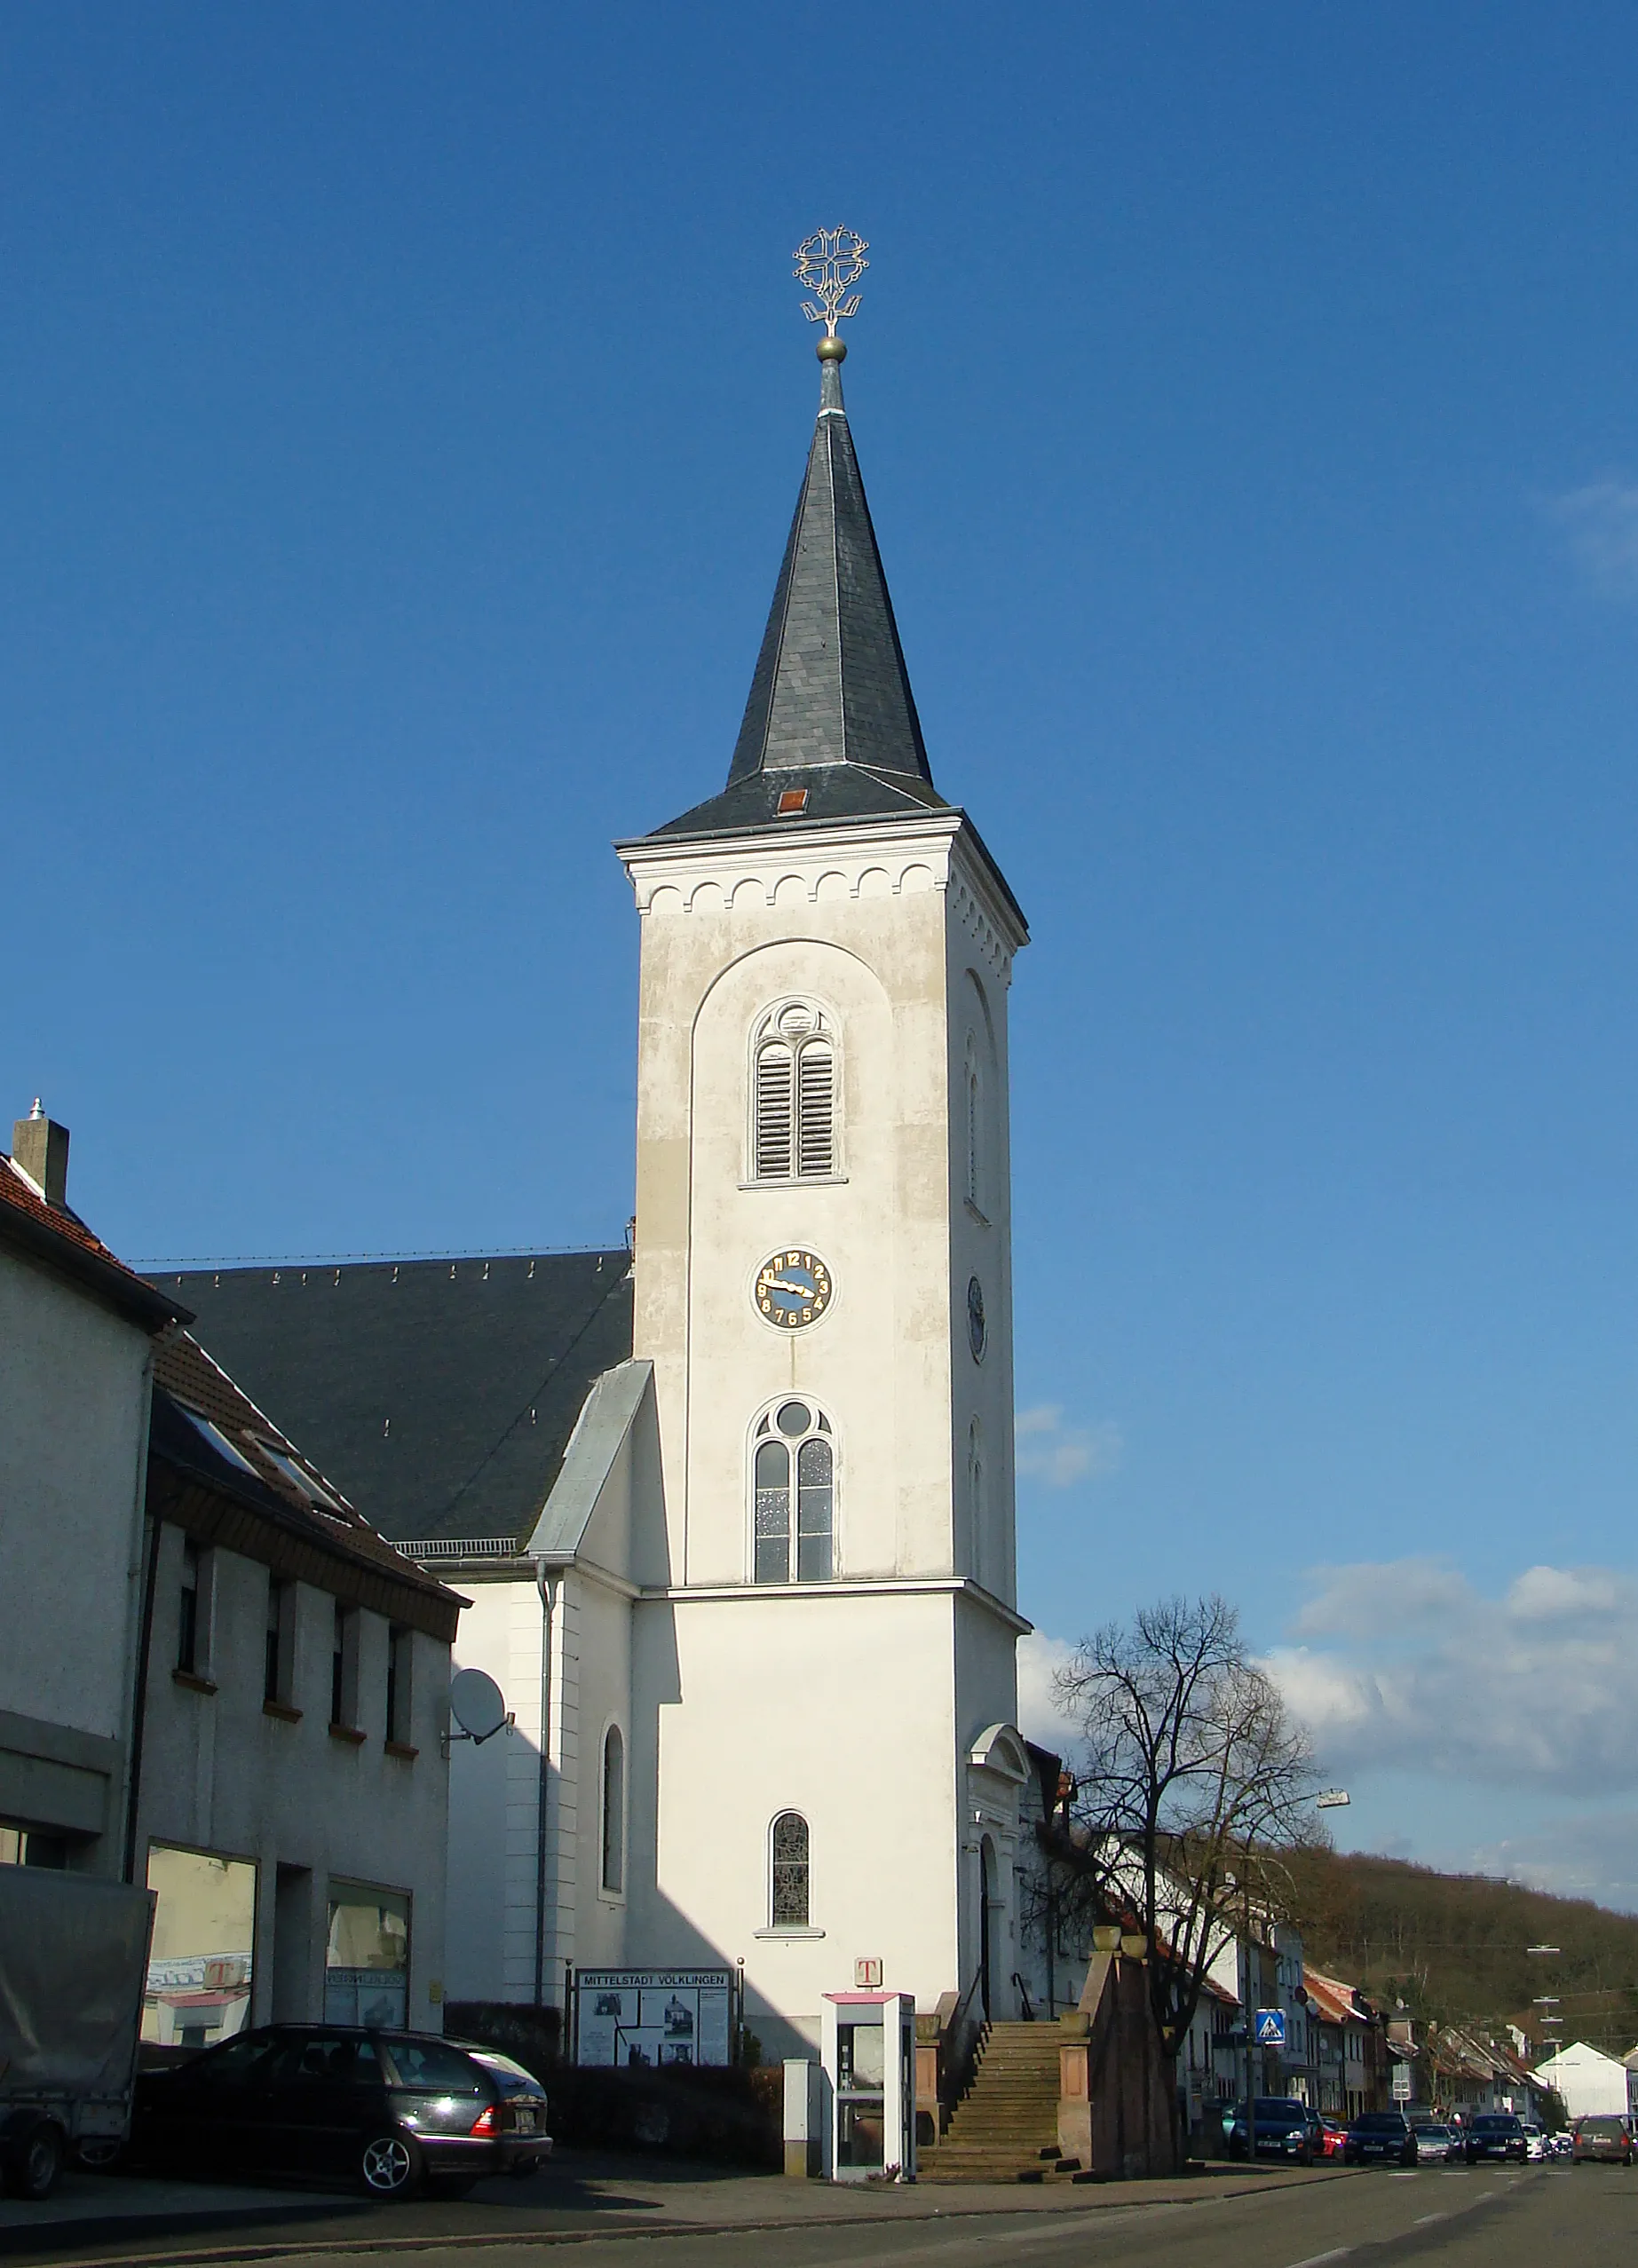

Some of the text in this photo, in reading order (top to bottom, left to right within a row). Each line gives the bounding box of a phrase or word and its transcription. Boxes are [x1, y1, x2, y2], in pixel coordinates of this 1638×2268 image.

[773, 1257, 783, 1271] 11
[787, 1252, 800, 1267] 12
[804, 1255, 811, 1269] 1
[762, 1268, 774, 1280] 10
[814, 1264, 825, 1279] 2
[757, 1284, 767, 1298] 9
[819, 1280, 828, 1294] 3
[761, 1299, 771, 1313] 8
[813, 1296, 824, 1310] 4
[775, 1308, 784, 1323] 7
[787, 1312, 797, 1326] 6
[803, 1308, 811, 1321] 5
[859, 1960, 876, 1983] T
[584, 1974, 724, 1985] MITTELSTADT VÖLKLINGEN
